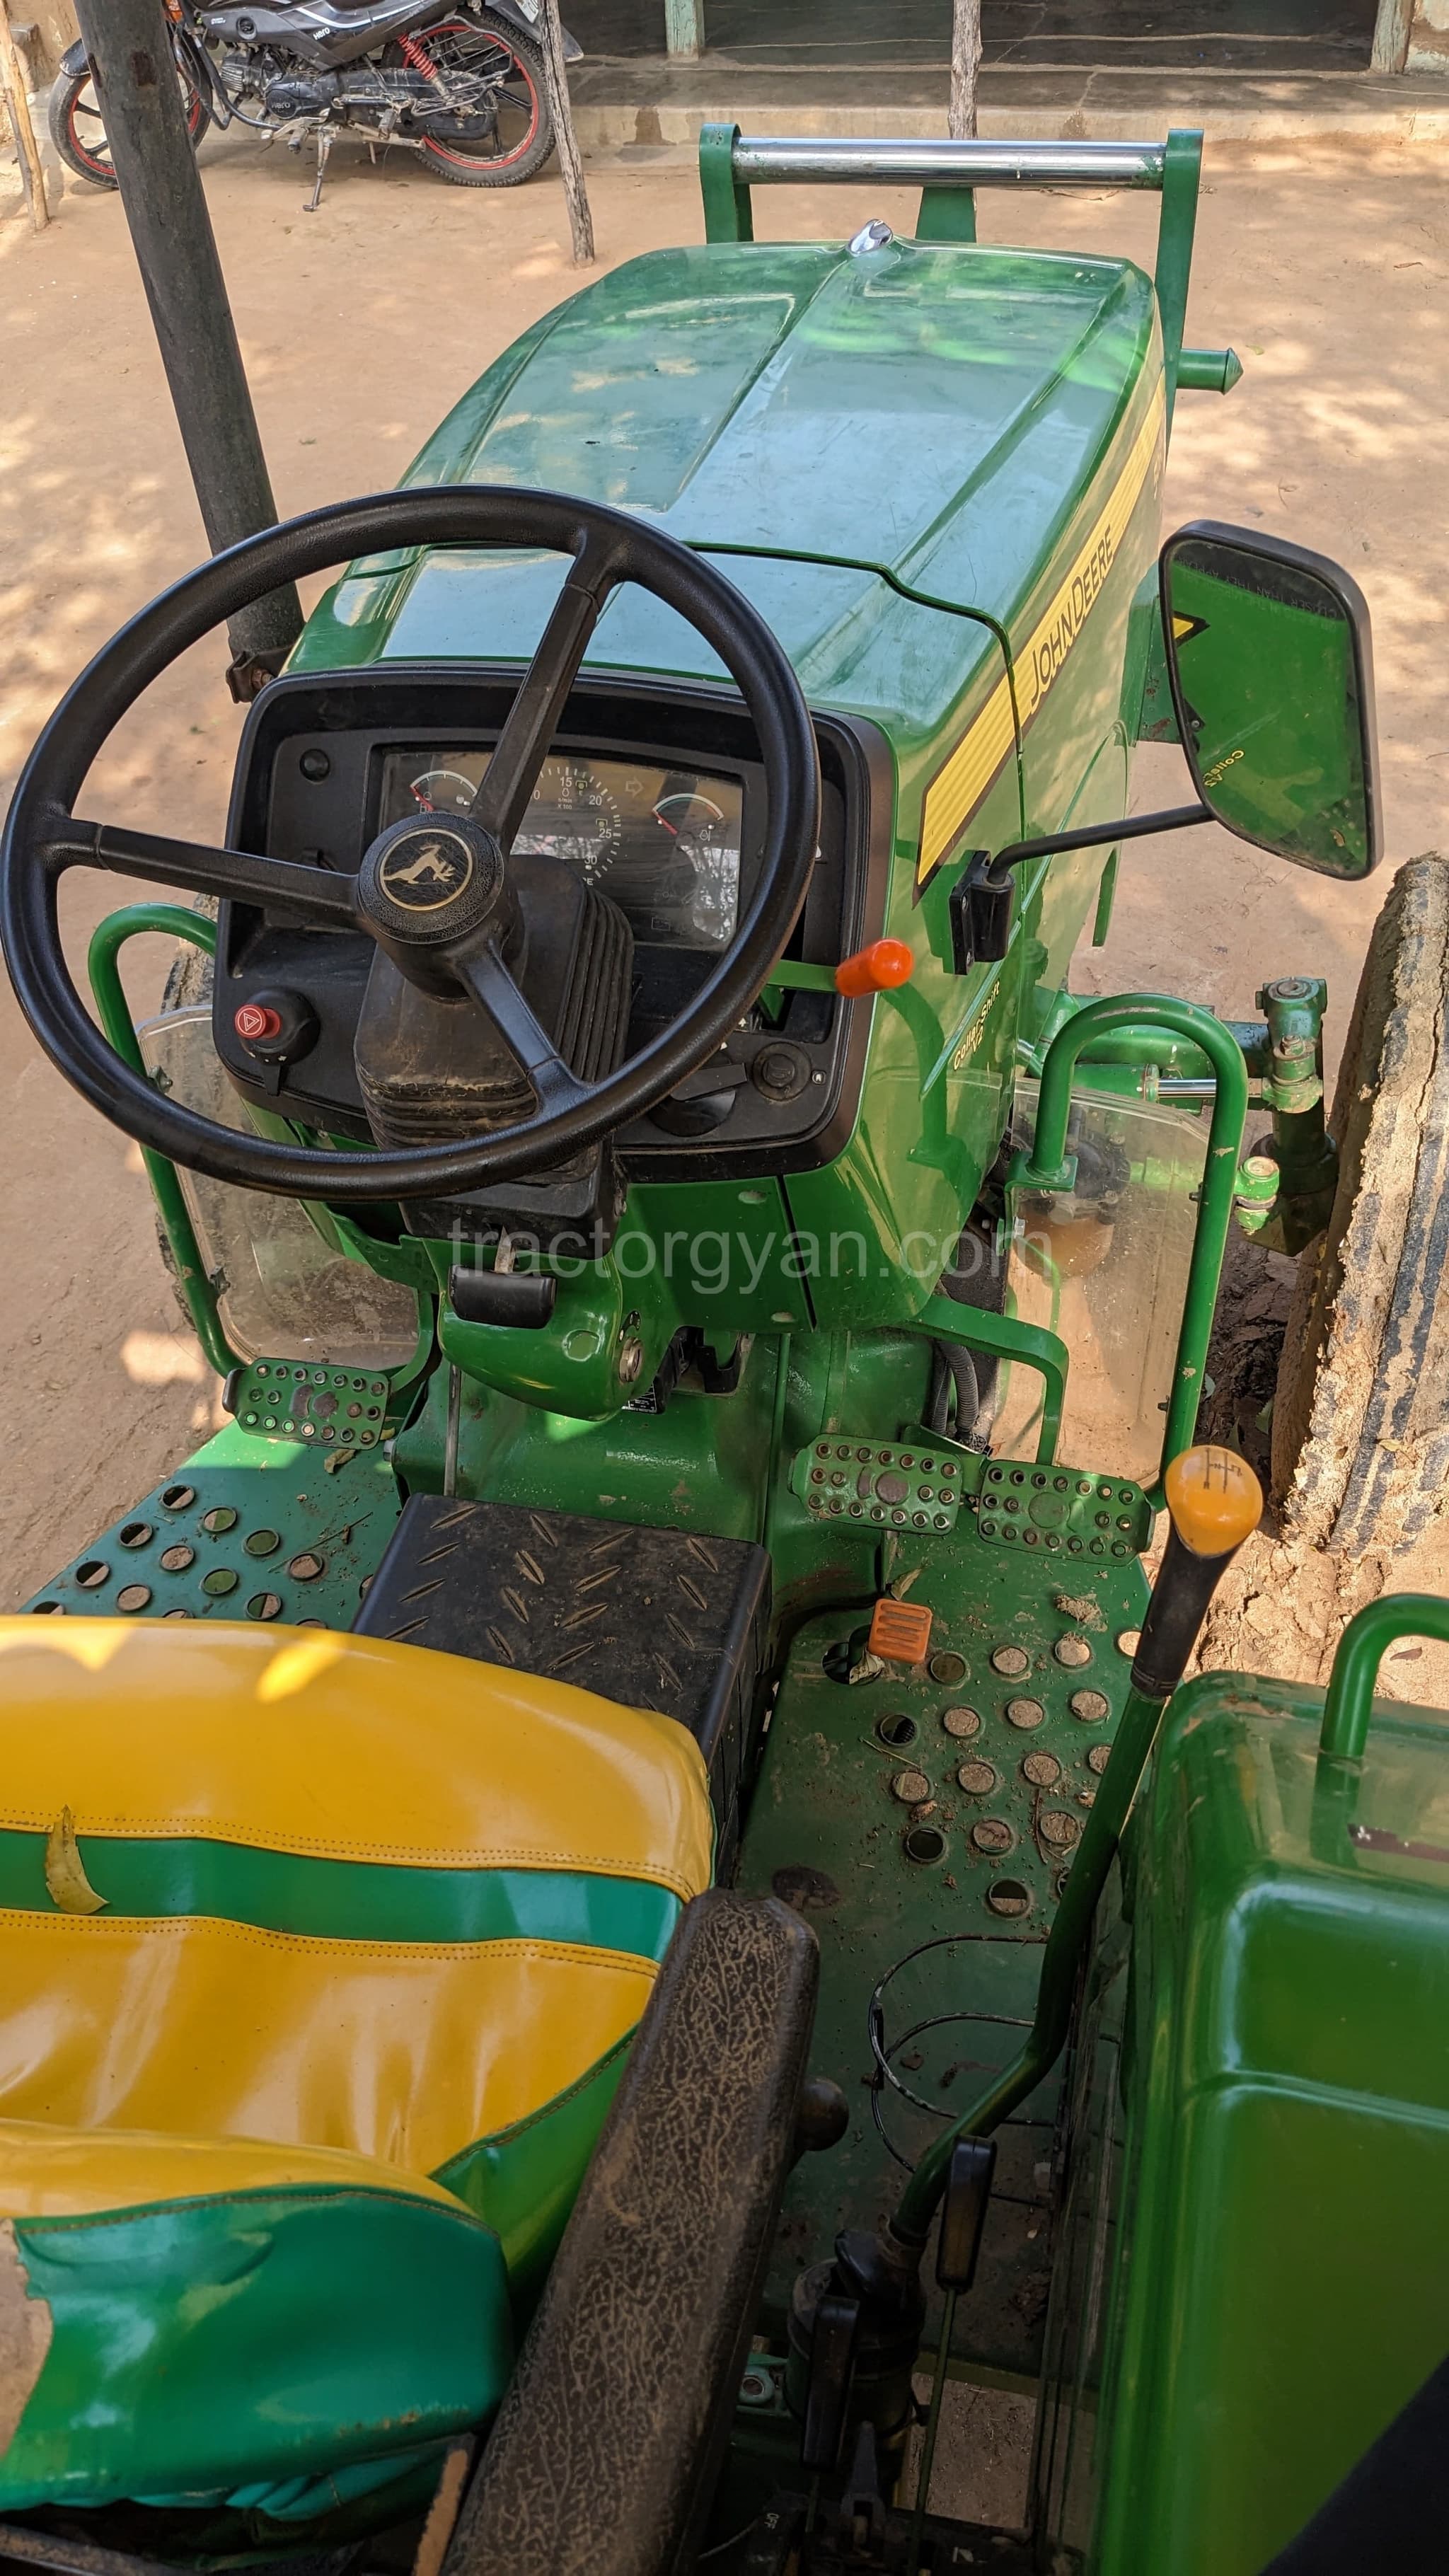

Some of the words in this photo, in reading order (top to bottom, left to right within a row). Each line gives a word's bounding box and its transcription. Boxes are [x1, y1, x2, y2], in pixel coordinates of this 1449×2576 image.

[1031, 601, 1073, 705] JOHN
[1071, 526, 1113, 623] DEERE
[560, 777, 572, 787] 15
[589, 795, 602, 806] 20
[599, 828, 612, 838] 25
[584, 854, 597, 865] 30
